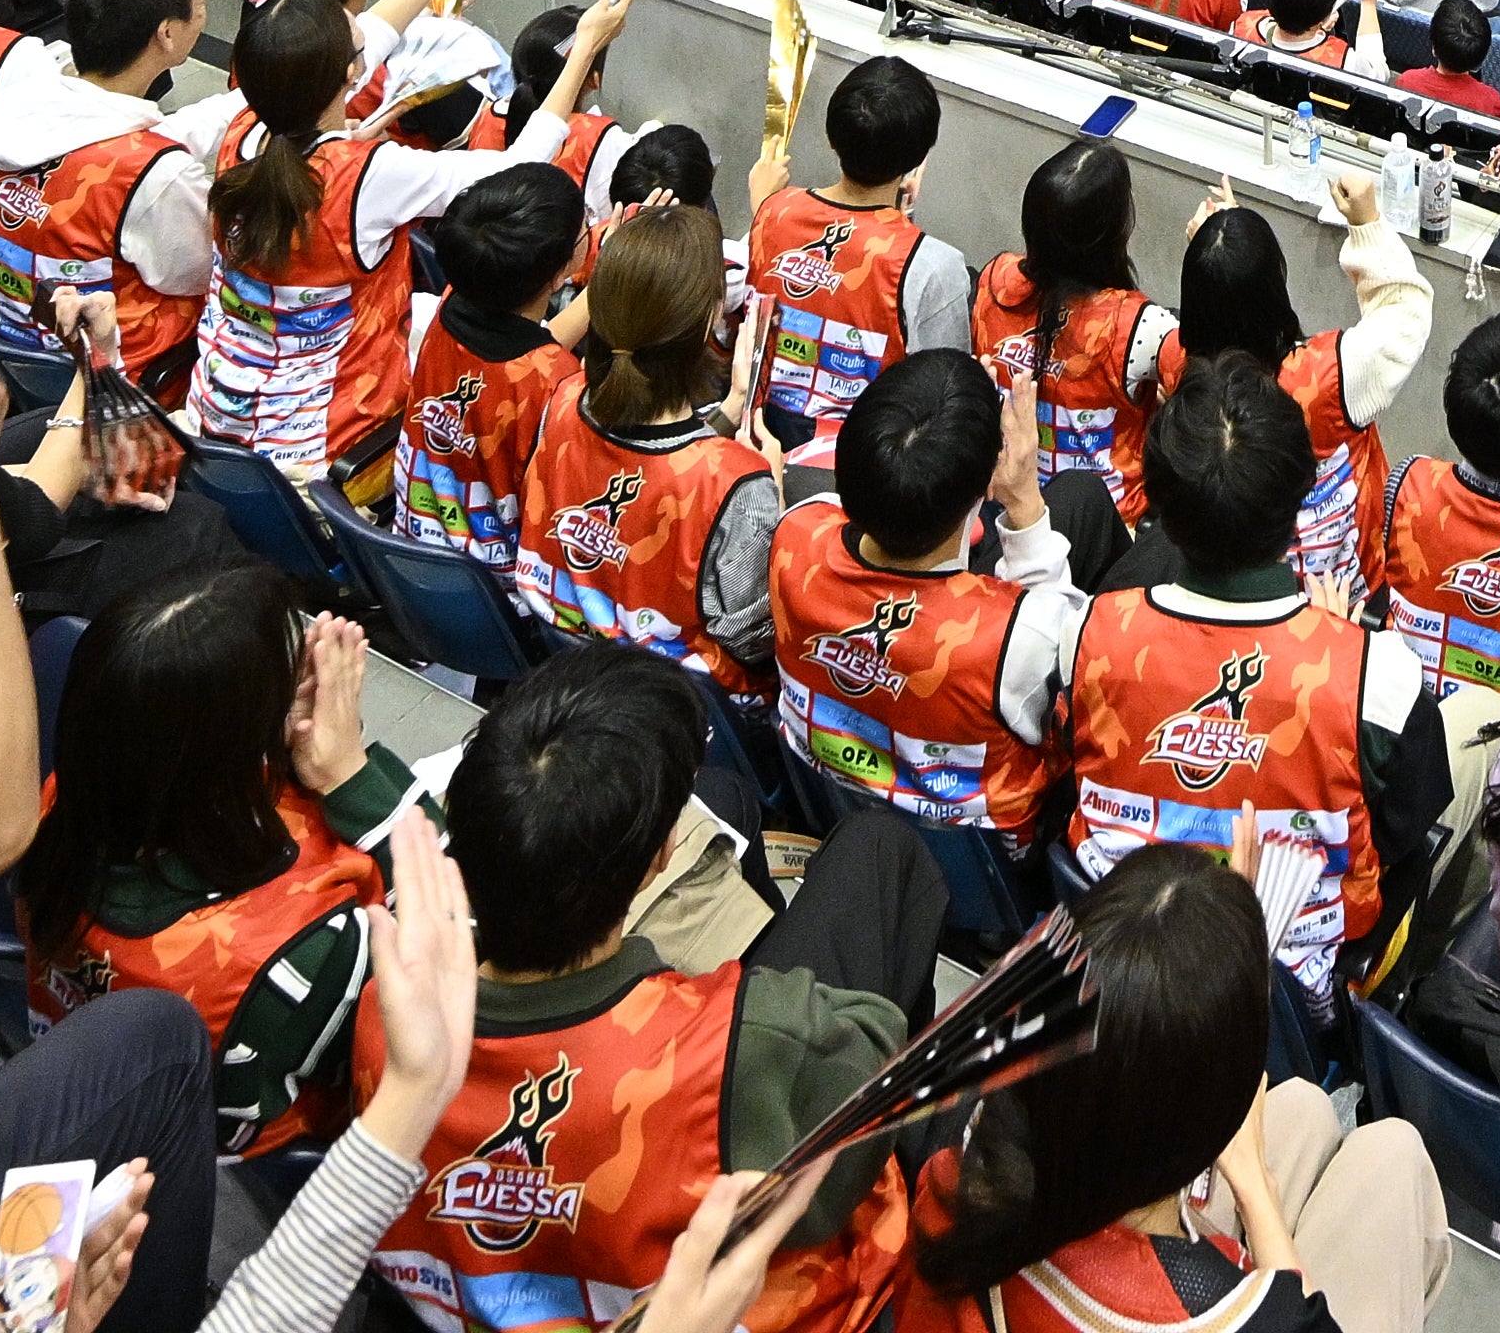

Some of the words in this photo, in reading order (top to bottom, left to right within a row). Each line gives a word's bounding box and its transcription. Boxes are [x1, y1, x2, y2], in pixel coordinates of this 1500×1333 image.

[776, 251, 840, 291] EVESSA
[2, 273, 23, 290] OFA
[783, 338, 807, 356] OFA
[830, 352, 866, 369] mizuho
[829, 375, 860, 393] TAIHO
[556, 510, 630, 564] EVESSA
[815, 637, 906, 692] EVESSA
[1203, 721, 1241, 735] OSAKA
[1153, 714, 1265, 765] EVESSA
[841, 745, 880, 769] OFA
[913, 797, 964, 816] TAIHO
[496, 1168, 545, 1187] OSAKA
[440, 1161, 583, 1220] EVESSA
